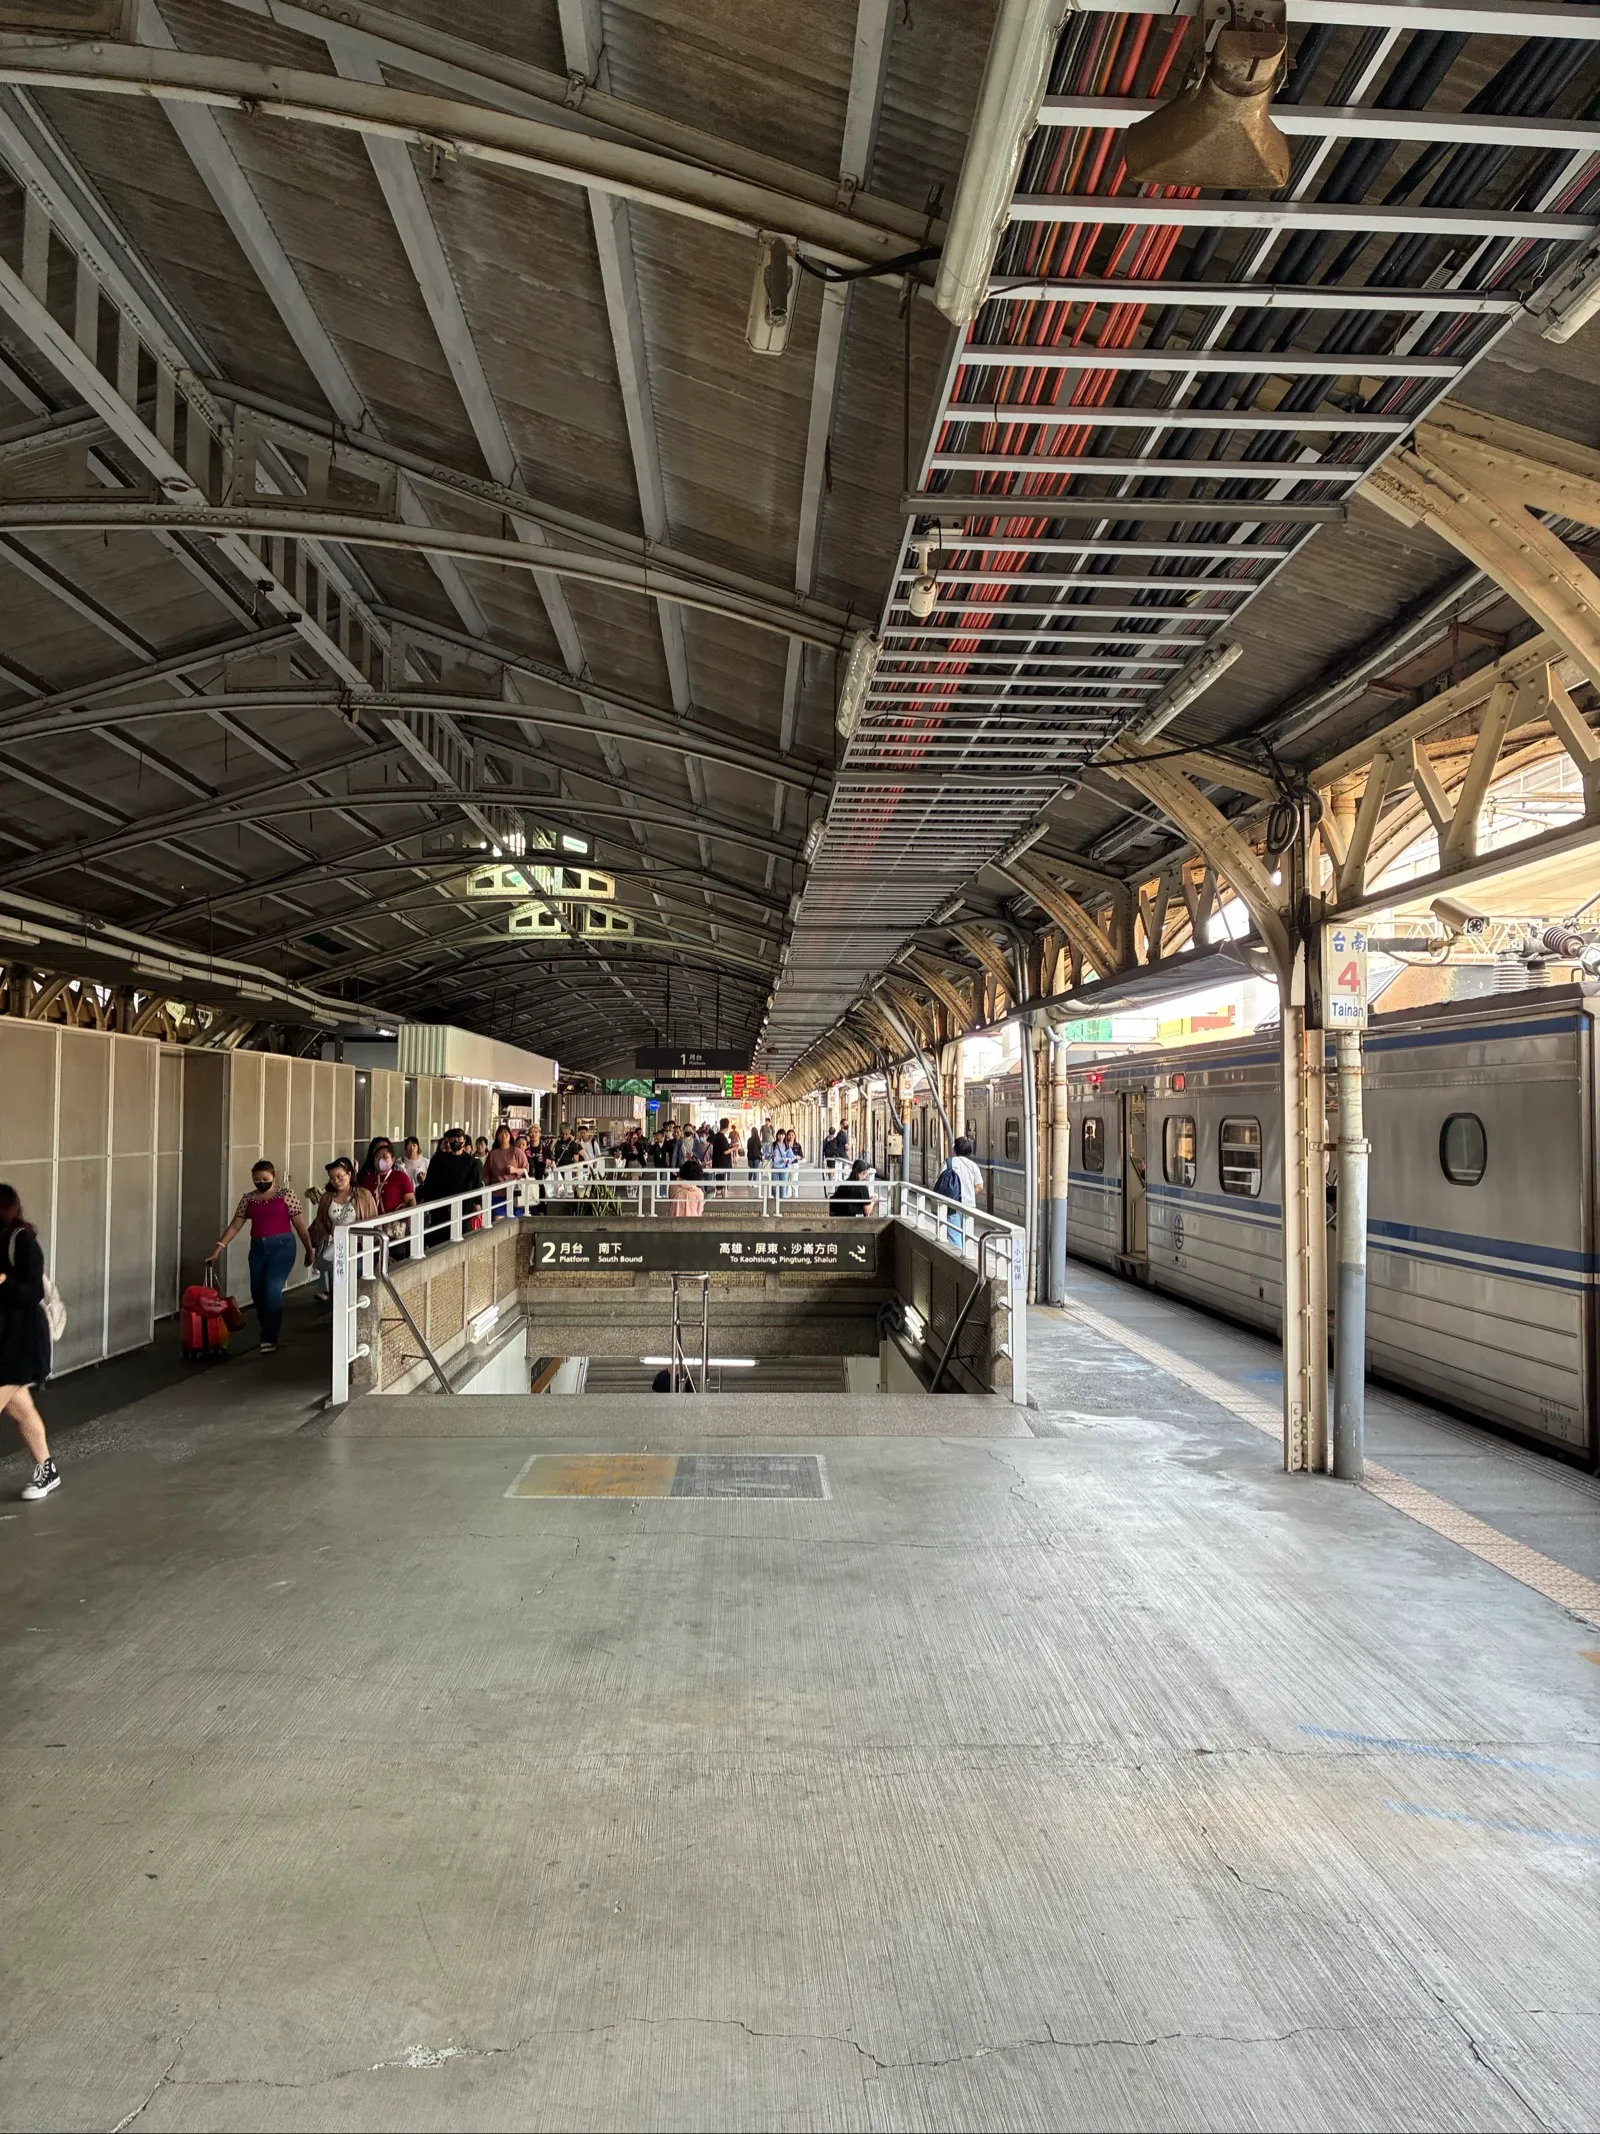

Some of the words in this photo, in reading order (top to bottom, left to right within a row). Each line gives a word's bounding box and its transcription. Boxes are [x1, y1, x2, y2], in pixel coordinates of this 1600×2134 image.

[1332, 930, 1367, 954] 台南
[1338, 961, 1361, 993] 4
[1332, 1002, 1364, 1018] Tainan
[680, 1053, 686, 1065] 1
[541, 1242, 556, 1263] 2
[560, 1243, 583, 1255] 月台
[598, 1243, 622, 1255] 南下
